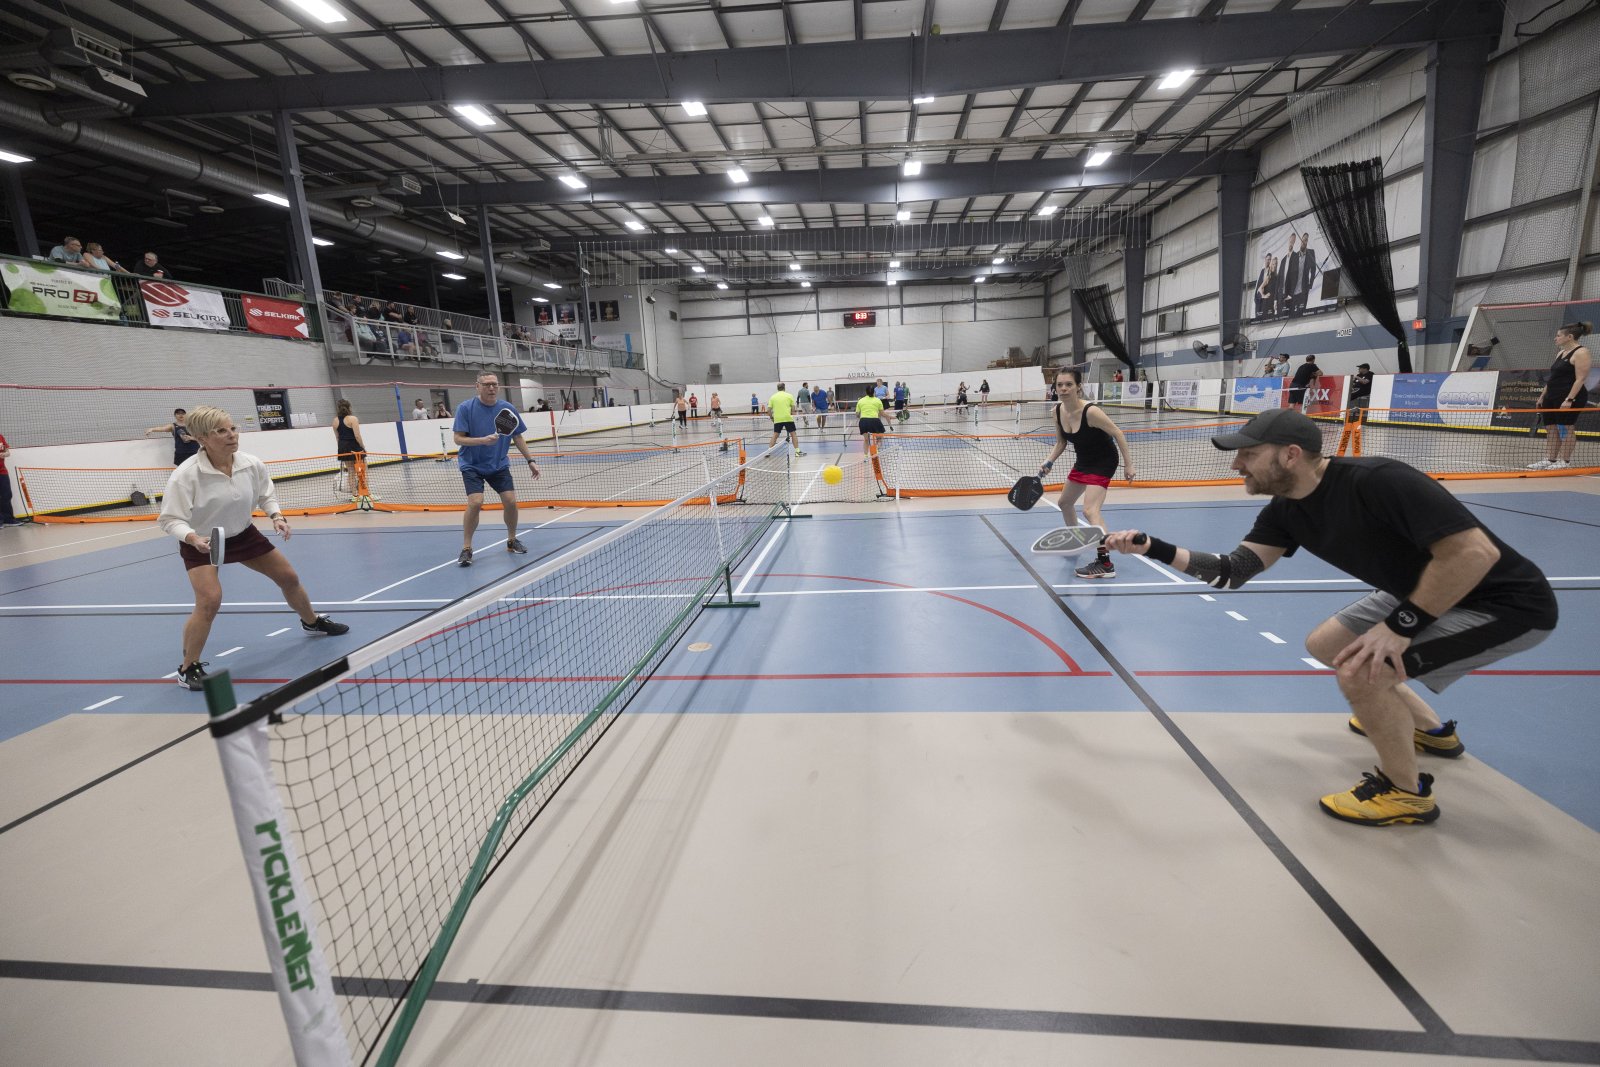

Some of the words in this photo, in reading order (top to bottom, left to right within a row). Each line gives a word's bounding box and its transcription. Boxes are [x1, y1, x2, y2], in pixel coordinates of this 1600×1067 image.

[32, 286, 70, 300] PRO
[173, 311, 226, 323] SELKIRK
[263, 311, 301, 321] SELKIRK
[1337, 328, 1352, 337] HOME
